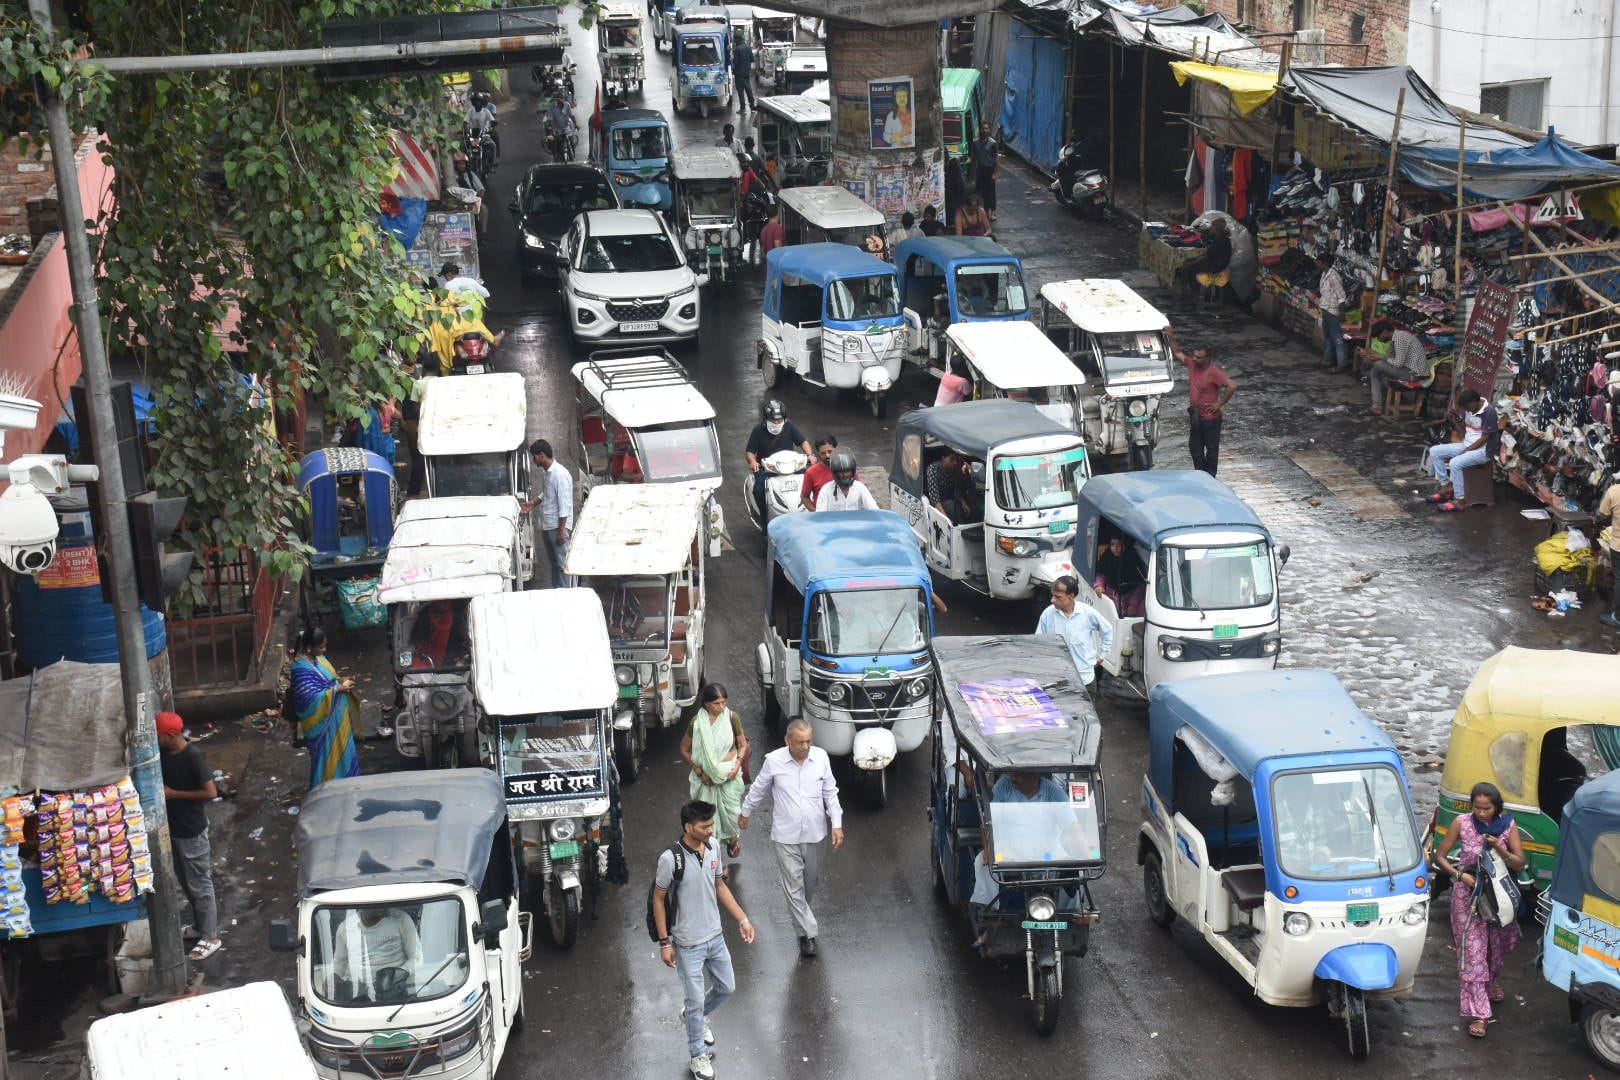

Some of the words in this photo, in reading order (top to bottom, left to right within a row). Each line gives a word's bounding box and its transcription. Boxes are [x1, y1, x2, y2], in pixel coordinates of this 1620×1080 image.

[509, 780, 538, 795] जय
[540, 773, 565, 792] श्री
[567, 774, 597, 792] राम
